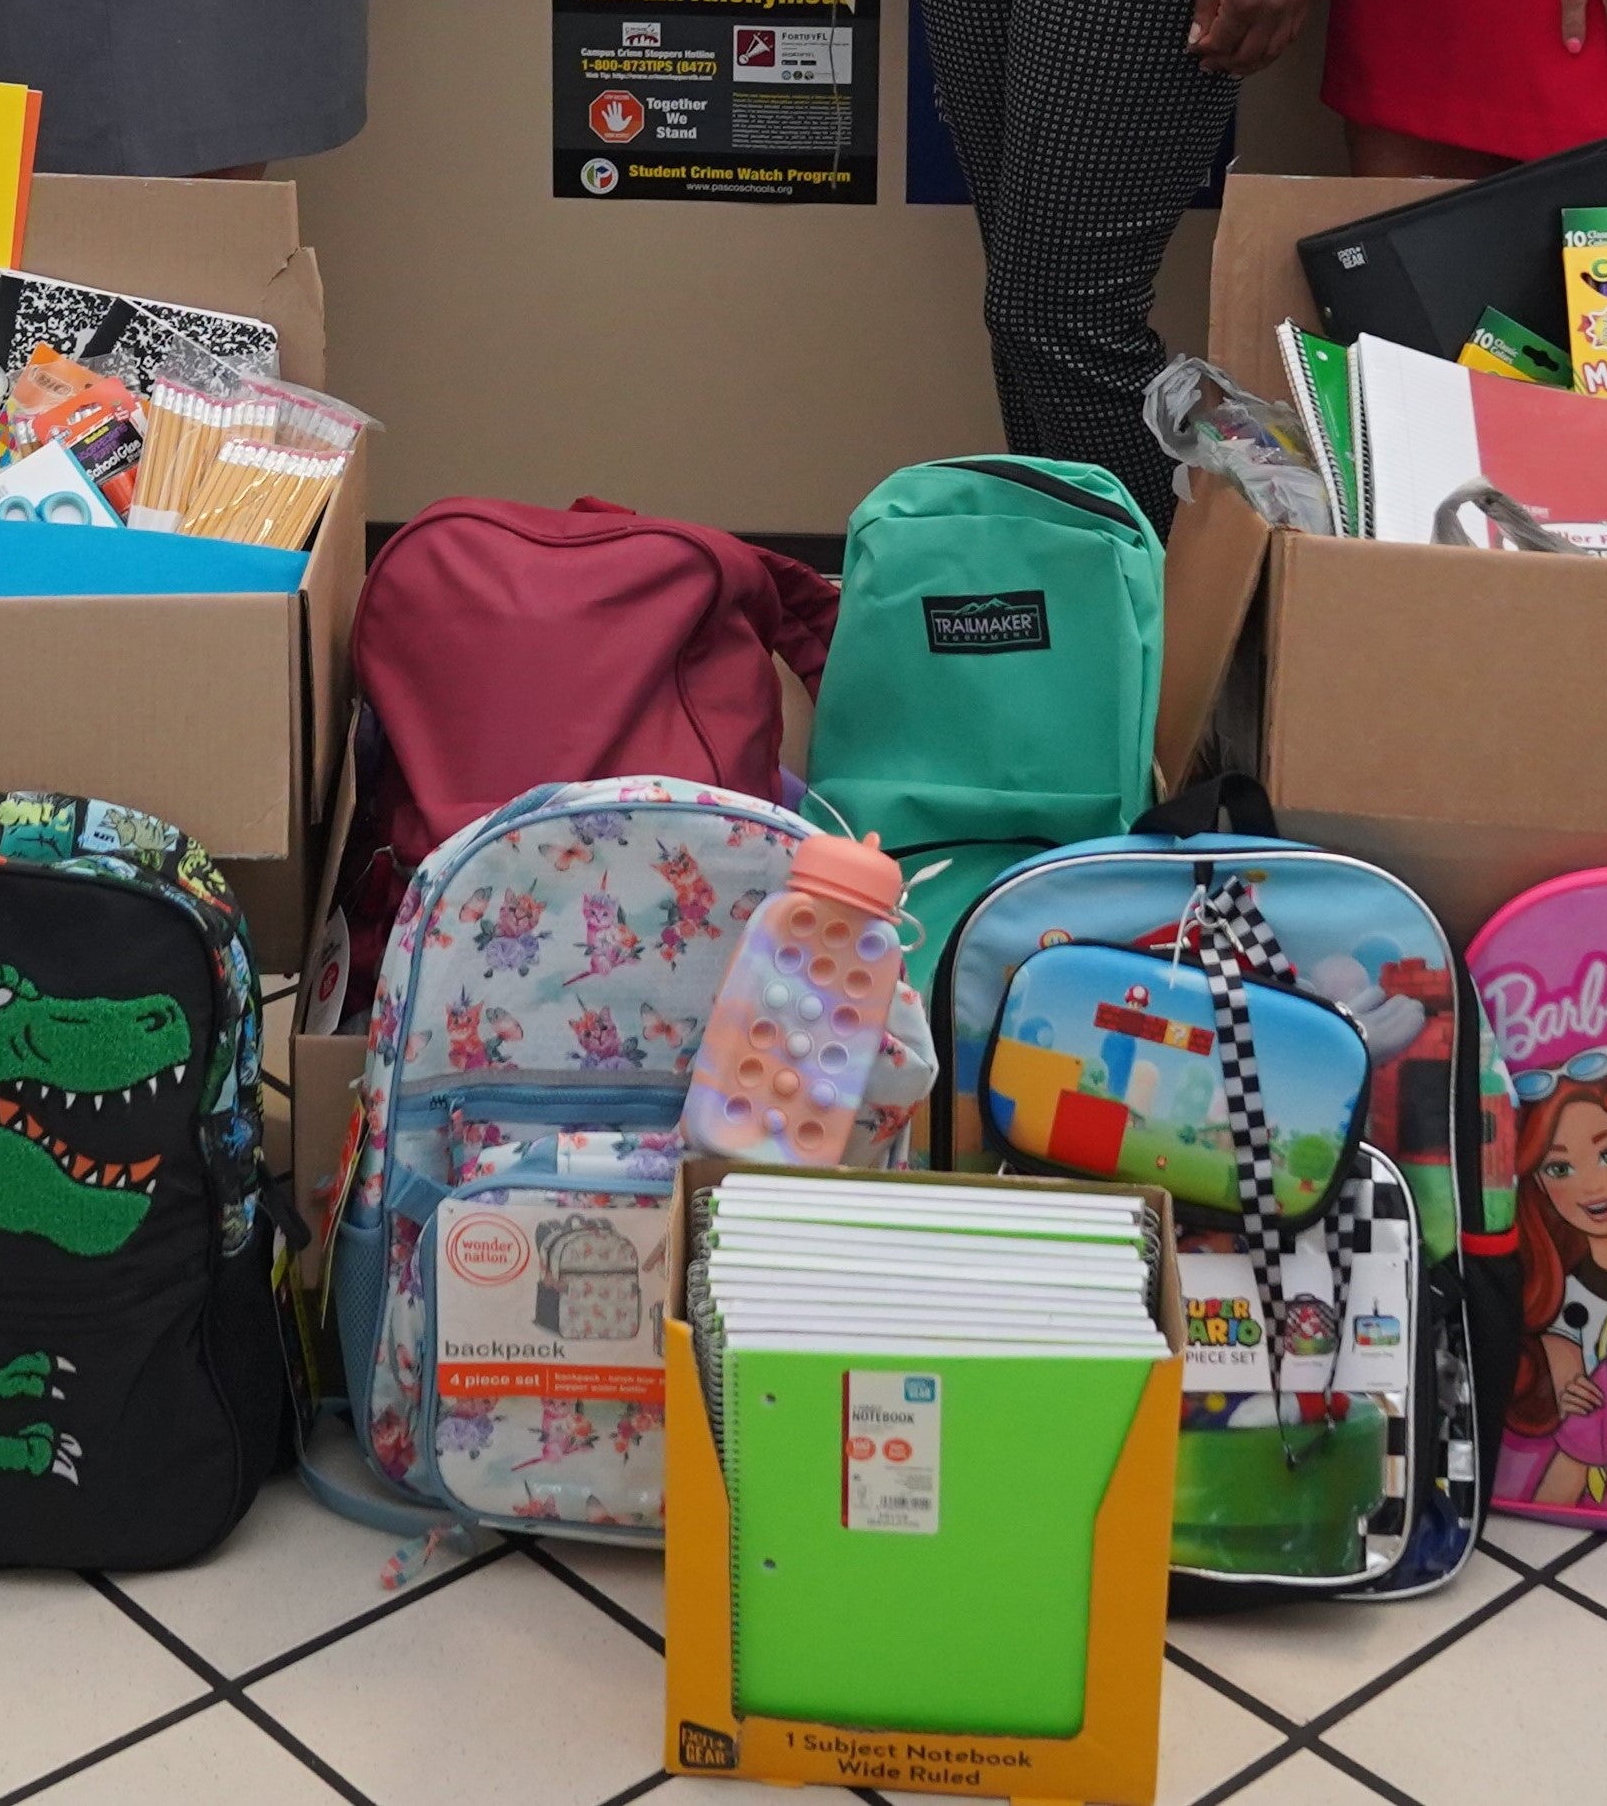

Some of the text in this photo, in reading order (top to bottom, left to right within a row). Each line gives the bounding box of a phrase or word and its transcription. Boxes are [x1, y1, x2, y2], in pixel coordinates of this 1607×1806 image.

[581, 48, 715, 59] Campus Crime Stoppers Hotline
[581, 59, 717, 75] 1-800-873TIPS (8477)
[646, 97, 708, 113] Together
[666, 112, 688, 125] We
[656, 126, 697, 140] Stand
[629, 164, 851, 183] Student Crime Watch Program
[686, 182, 793, 194] www.pascoschools.org
[1565, 230, 1585, 247] 10
[1473, 328, 1494, 347] 10
[86, 439, 142, 481] School Glue
[935, 614, 1033, 634] TRAILMAKER
[463, 1238, 513, 1252] wonder
[464, 1250, 508, 1264] nation
[445, 1340, 566, 1360] backpack
[1186, 1350, 1257, 1365] PIECE SET
[450, 1373, 540, 1388] 4 piece set
[852, 1410, 915, 1424] NOTEBOOK
[787, 1732, 1032, 1768] 1 Subject Notebook
[838, 1759, 982, 1786] Wide Ruled
